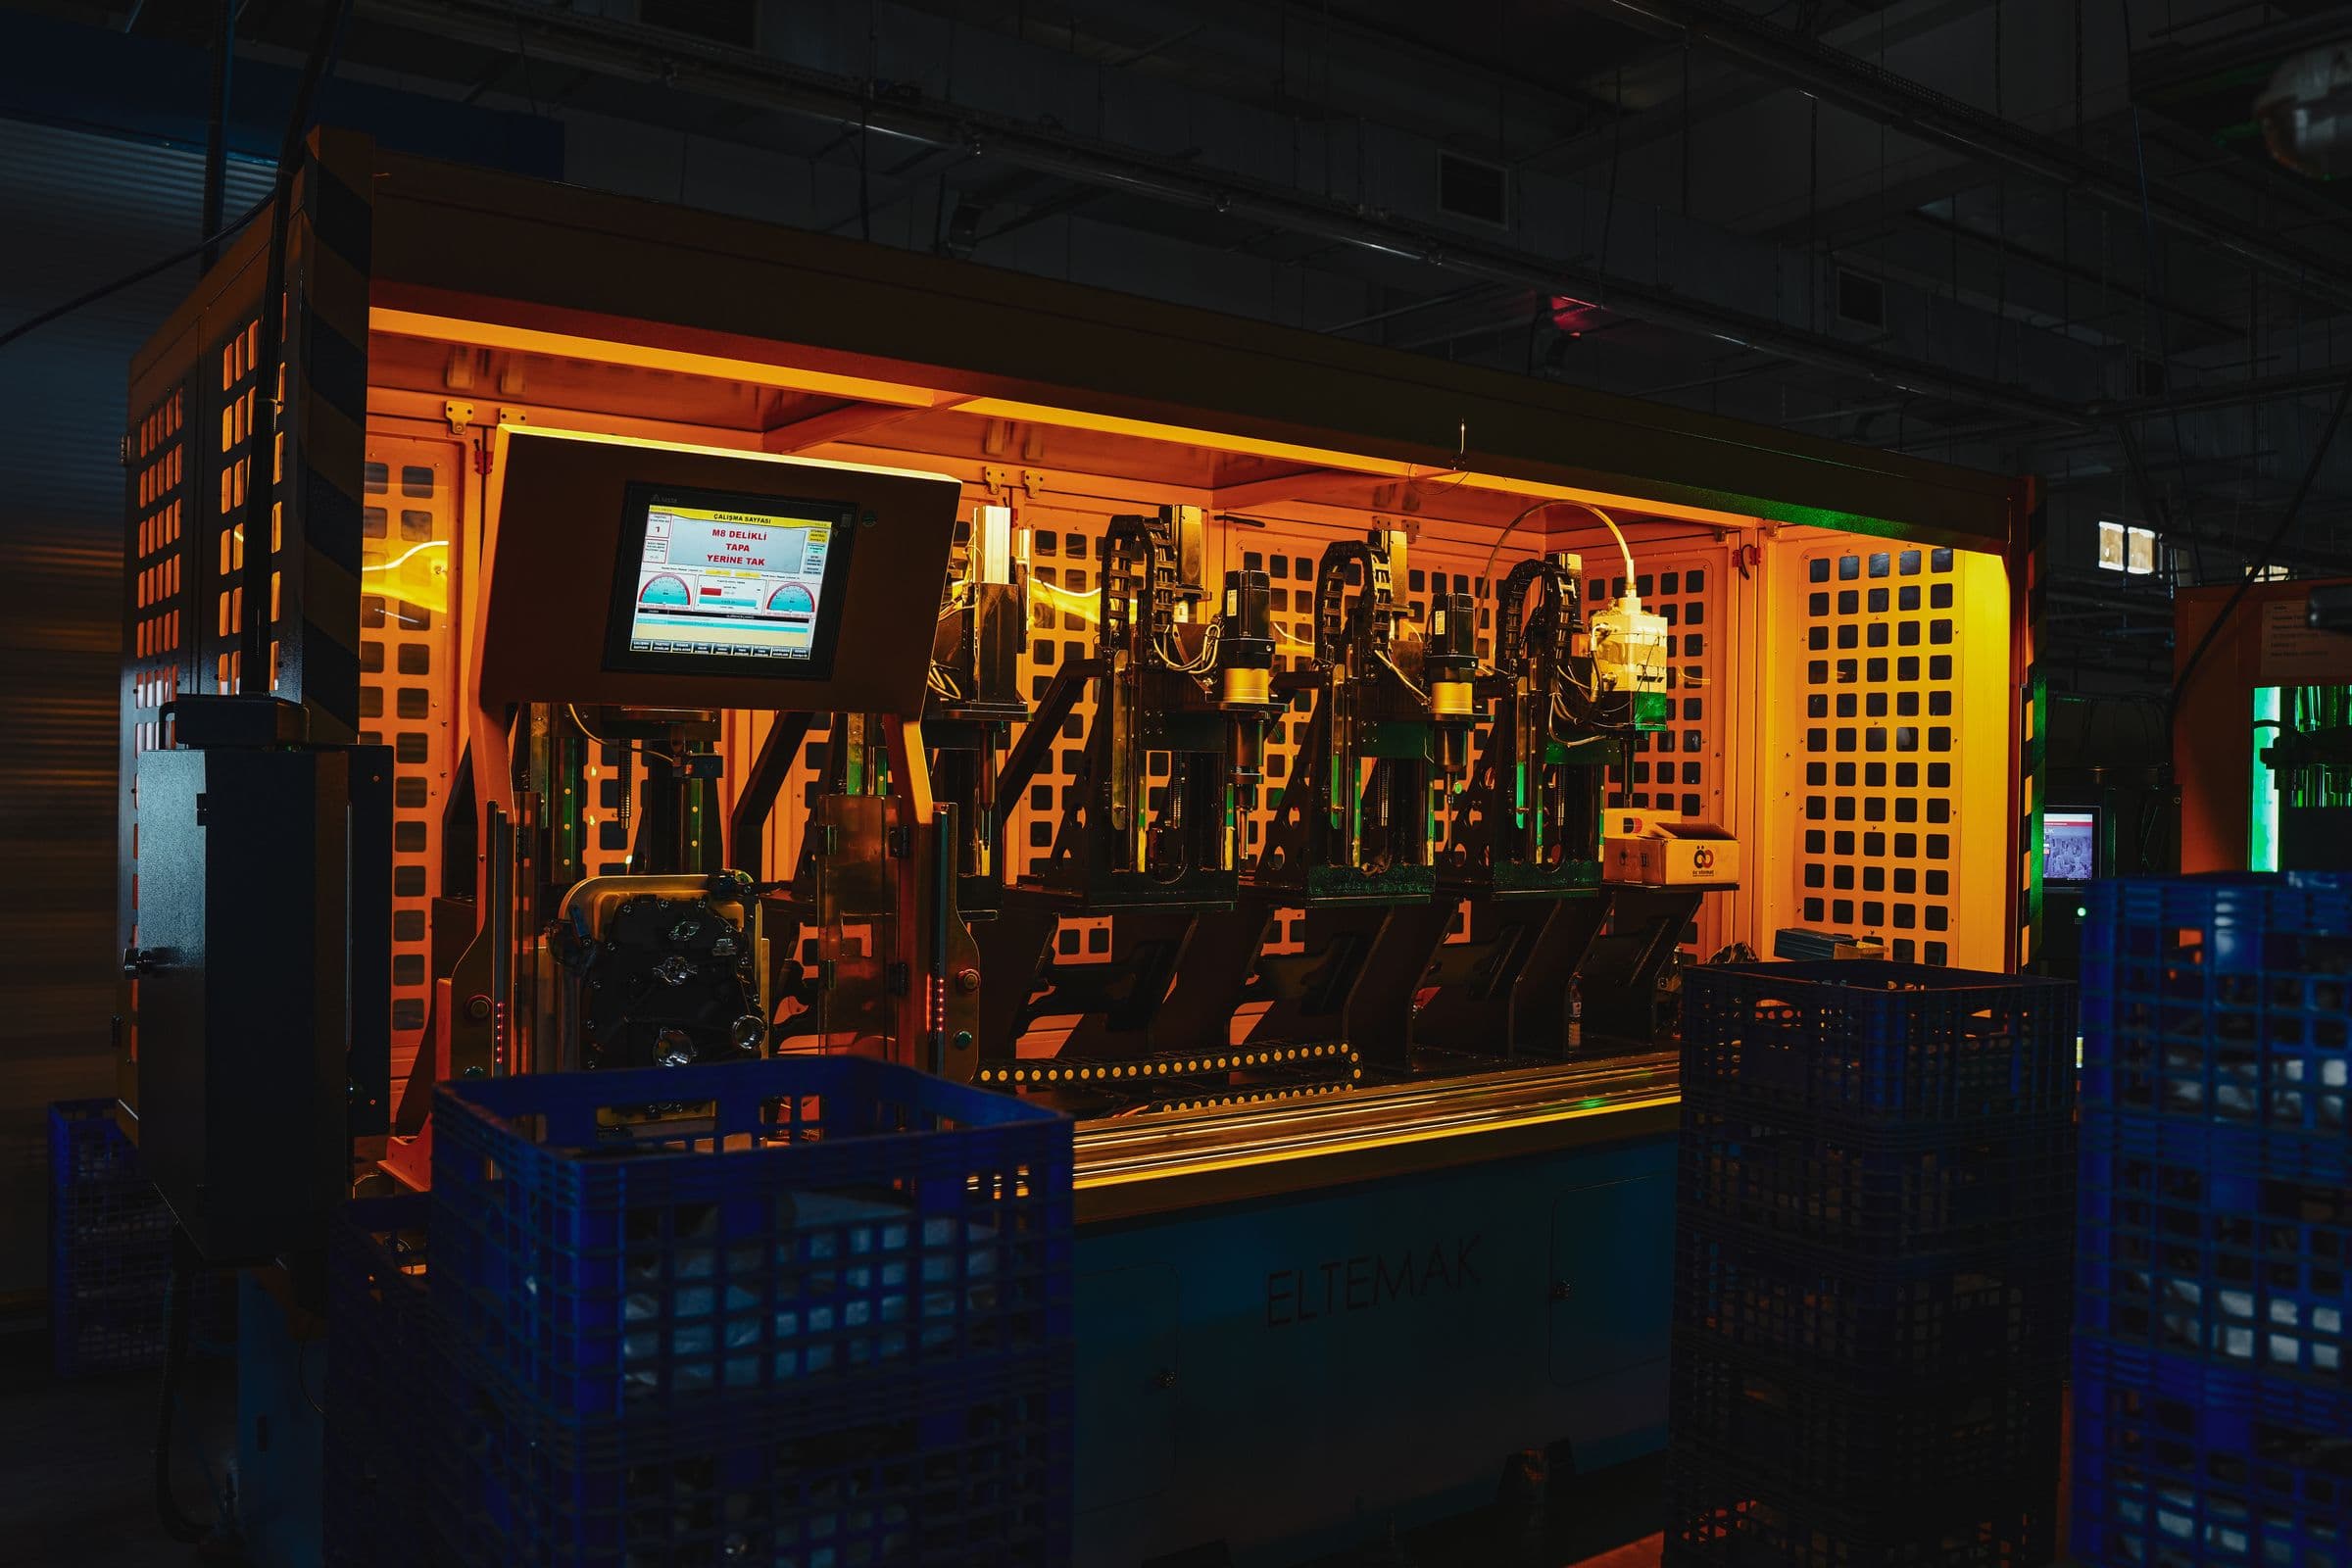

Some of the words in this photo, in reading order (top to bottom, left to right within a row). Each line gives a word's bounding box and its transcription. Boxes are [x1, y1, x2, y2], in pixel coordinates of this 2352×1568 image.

[713, 514, 743, 522] ÇALIŞMA
[729, 530, 767, 541] DELİKLİ
[726, 543, 750, 552] TAPA
[707, 554, 743, 564] YERİNE
[1267, 1233, 1482, 1328] ELTEMAK
